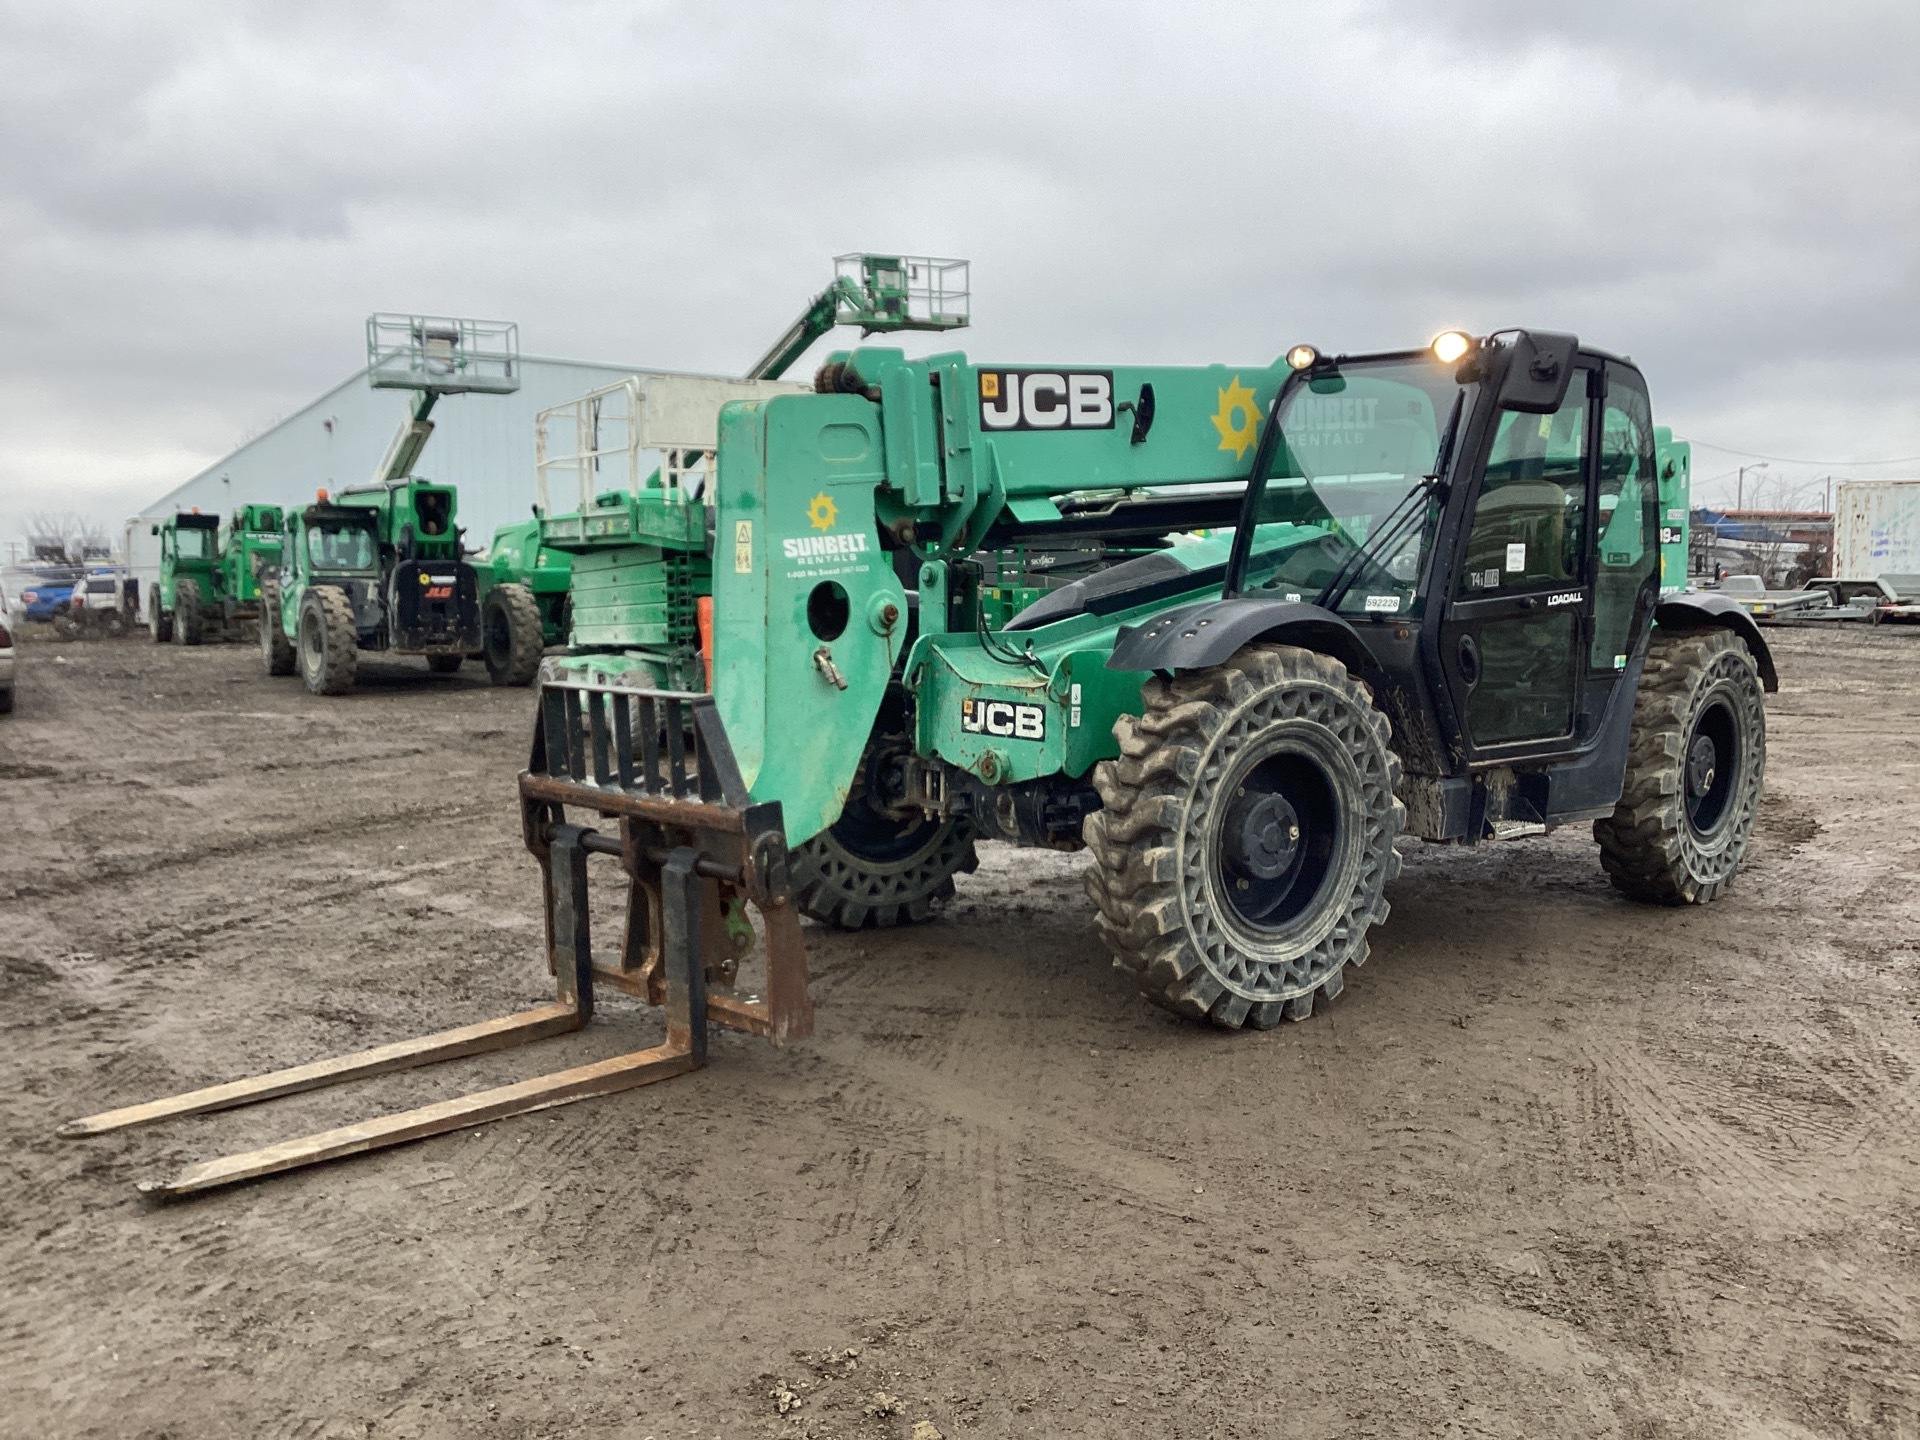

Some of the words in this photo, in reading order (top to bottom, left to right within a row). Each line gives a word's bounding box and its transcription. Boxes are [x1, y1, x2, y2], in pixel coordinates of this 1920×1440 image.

[982, 373, 1112, 427] JCB
[1268, 398, 1379, 431] UNBELT
[783, 533, 866, 558] SUNBELT
[798, 553, 857, 565] RENTALS
[1471, 572, 1484, 587] T4i
[1366, 599, 1399, 608] 592228
[1547, 593, 1583, 606] LOADALL
[963, 701, 1044, 739] JCB
